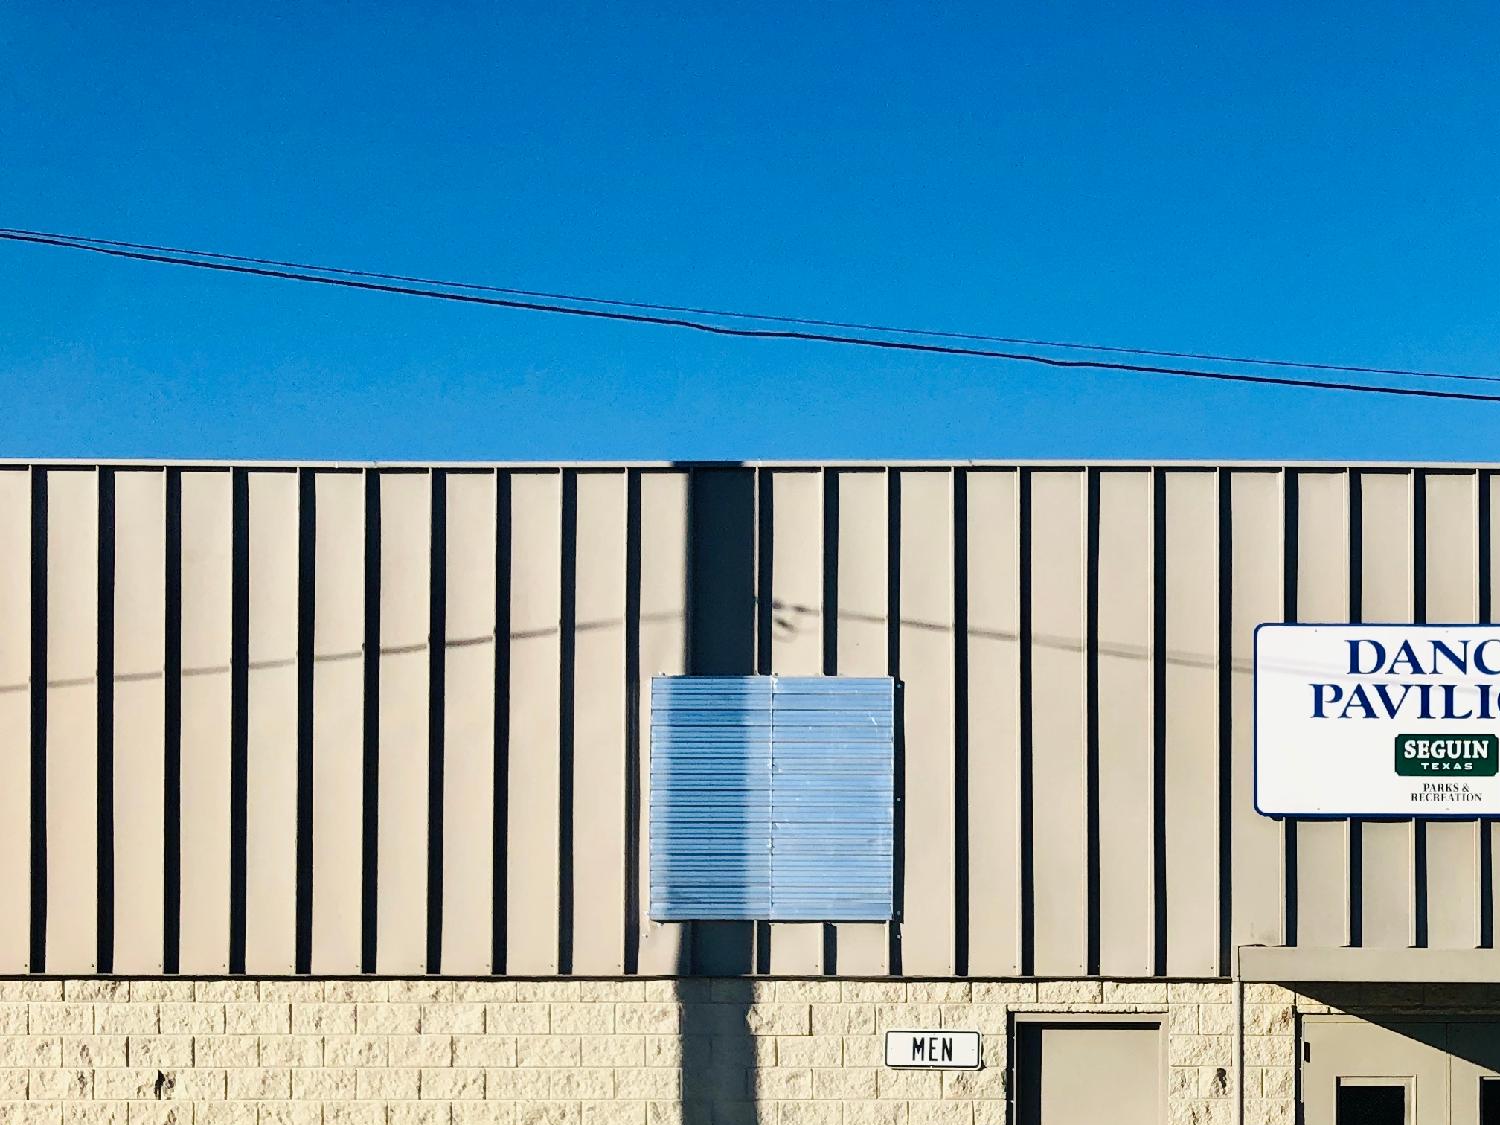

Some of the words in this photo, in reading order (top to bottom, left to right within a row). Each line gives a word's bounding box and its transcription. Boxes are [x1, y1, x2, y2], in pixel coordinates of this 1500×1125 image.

[1403, 739, 1489, 759] SEGUIN
[1420, 762, 1473, 770] TEXAS
[1422, 783, 1459, 793] PARKS
[1461, 783, 1470, 793] &
[1410, 792, 1482, 802] RECREATION
[912, 1036, 953, 1062] MEN
